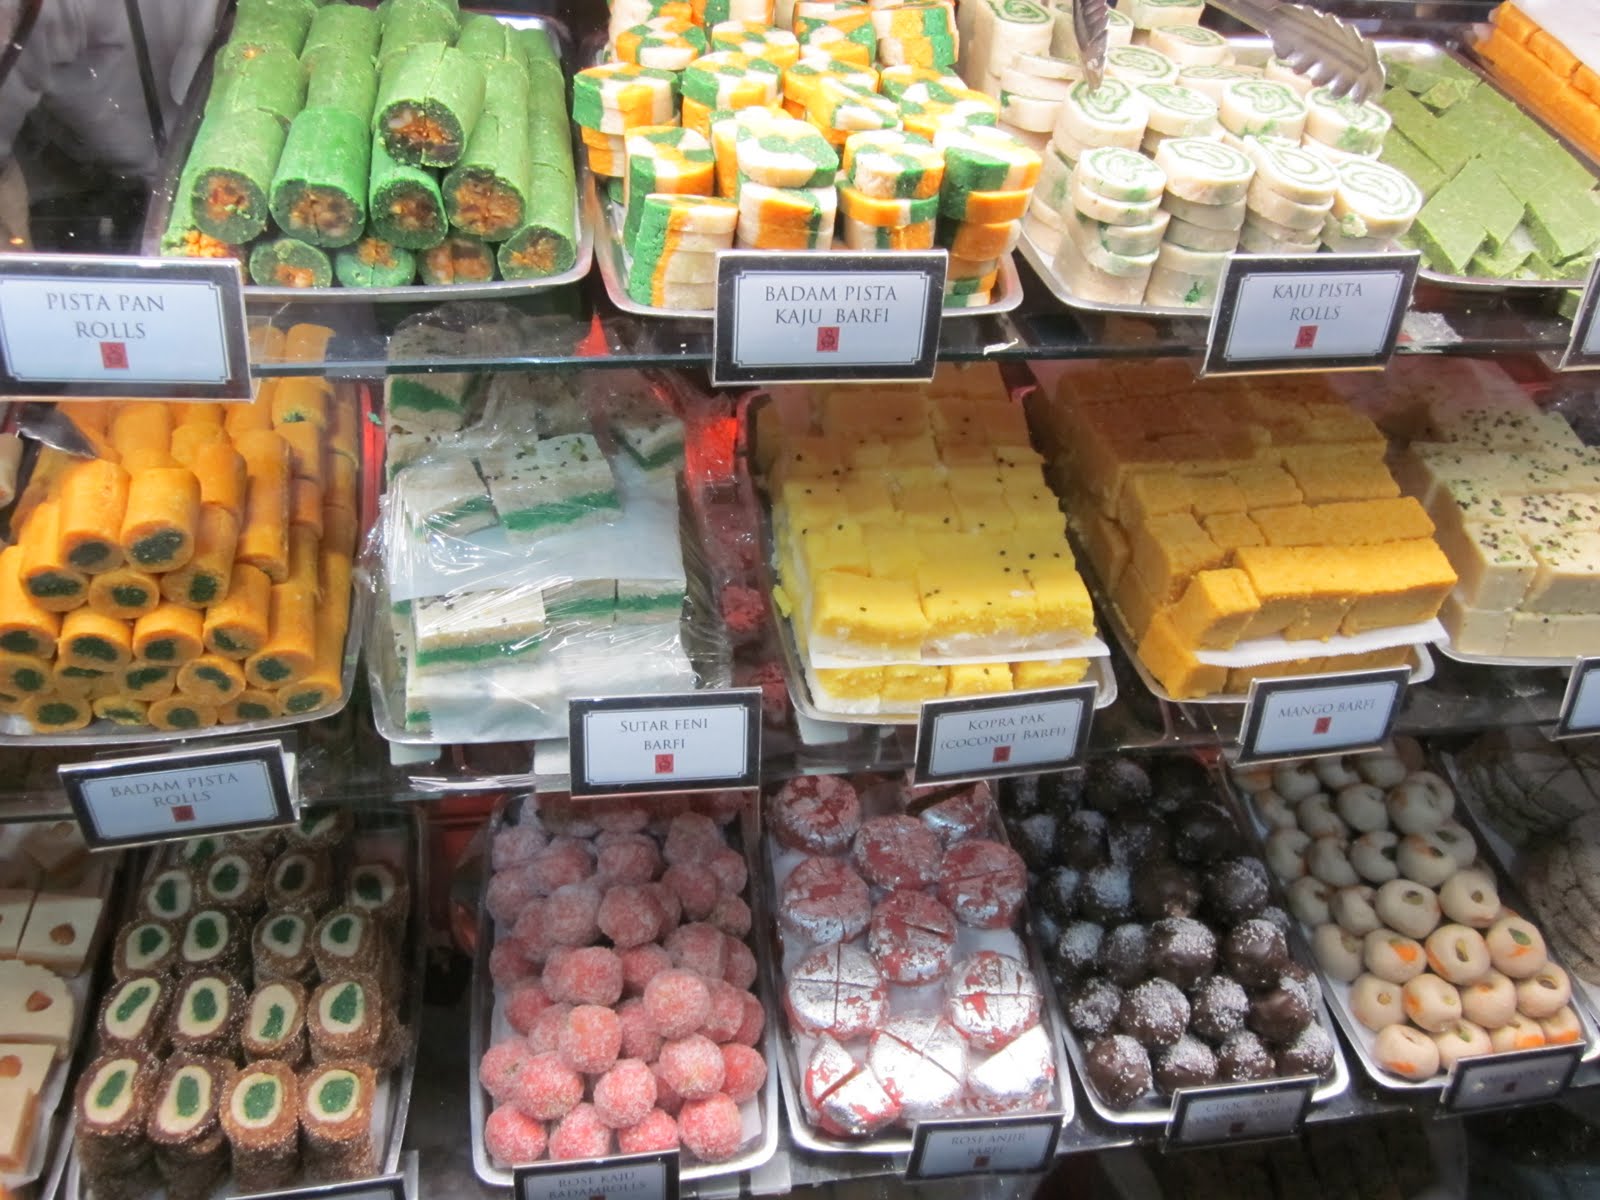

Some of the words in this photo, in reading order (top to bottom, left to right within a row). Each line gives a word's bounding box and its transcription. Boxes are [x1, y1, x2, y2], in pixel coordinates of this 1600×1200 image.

[765, 286, 836, 301] BADAM
[845, 285, 897, 301] PISTA
[1272, 284, 1314, 300] KAJU
[1319, 282, 1362, 298] PISTA
[47, 292, 111, 311] PISTA
[119, 295, 165, 312] PAN
[775, 308, 822, 327] KAJU
[836, 308, 889, 323] BARFI
[1289, 306, 1341, 321] ROLLS
[75, 321, 146, 339] ROLLS
[1278, 703, 1333, 718] MANGO
[1337, 699, 1376, 713] BARFI
[620, 720, 669, 733] SUTAR
[675, 718, 708, 730] FENI
[968, 717, 1015, 731] KOPRA
[1020, 713, 1047, 725] PAK
[644, 739, 685, 750] BARFI
[940, 733, 1017, 750] (COCONUT
[111, 779, 180, 798] BADAM
[188, 772, 239, 788] PISTA
[153, 791, 212, 807] ROLLS
